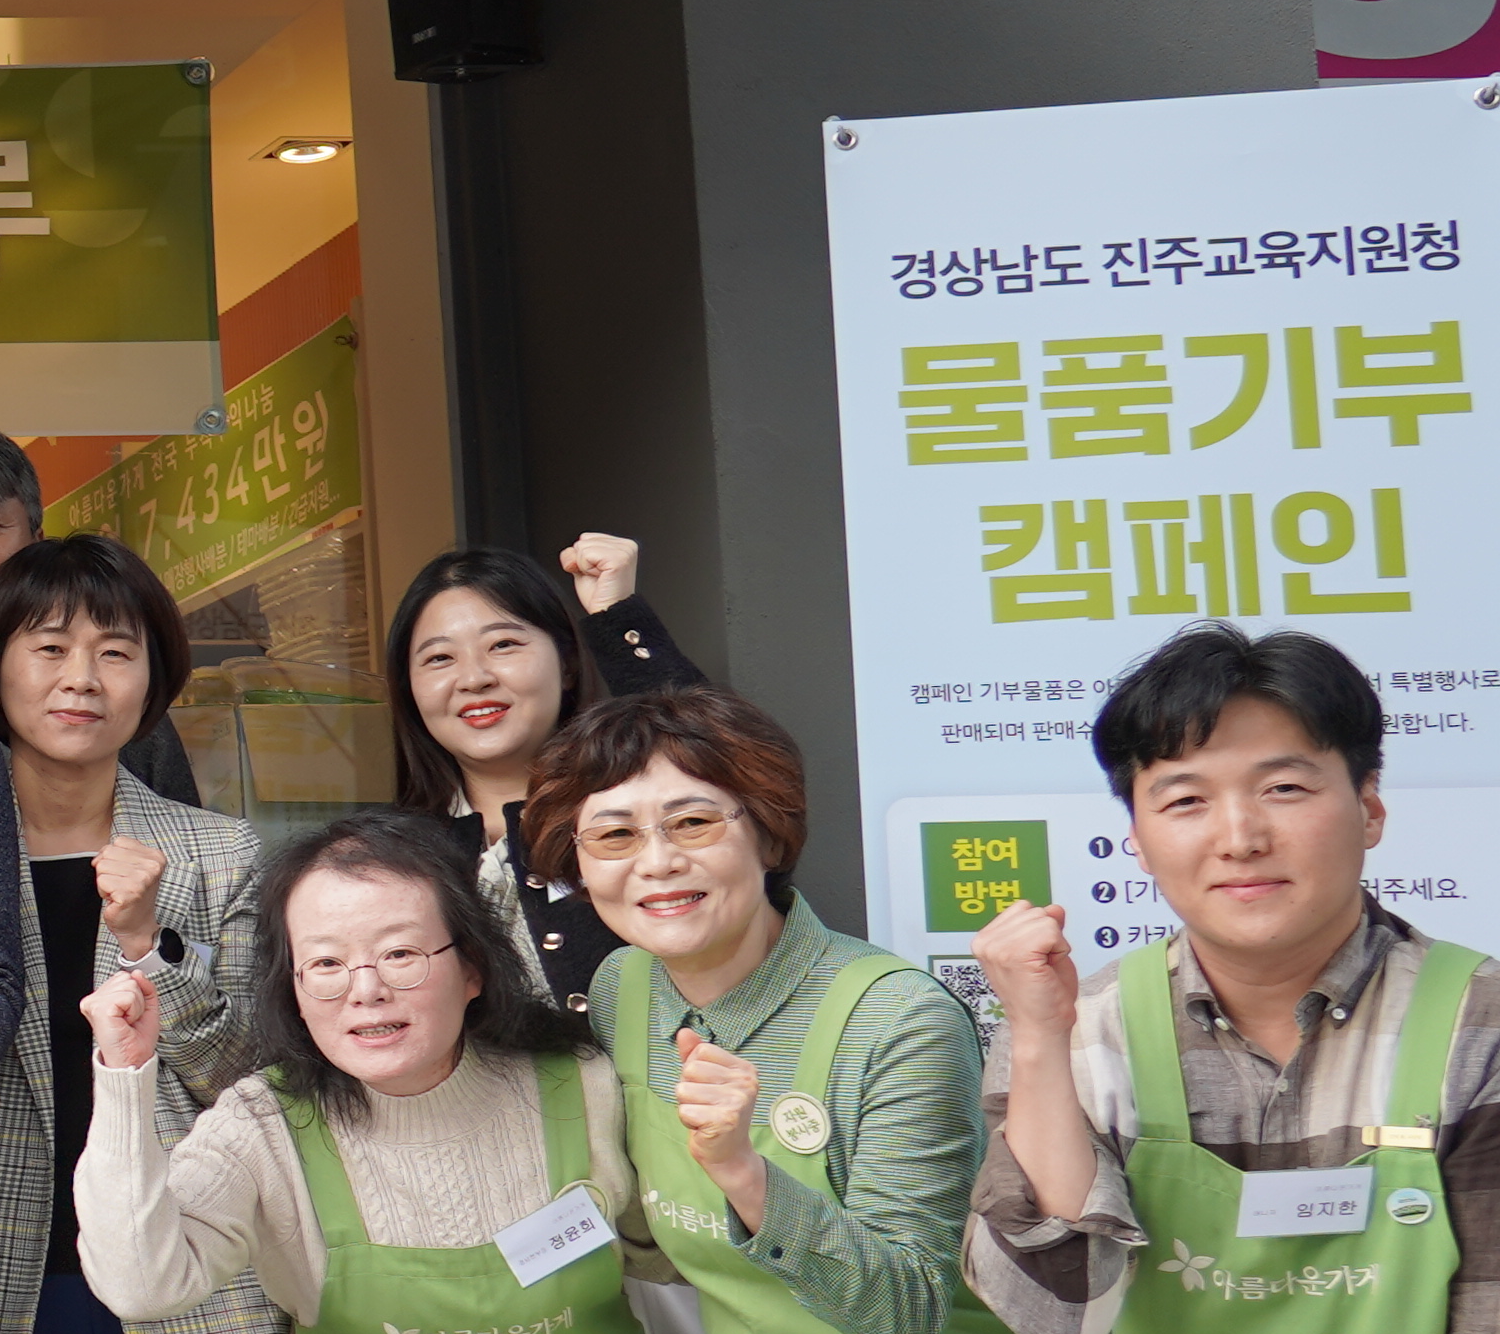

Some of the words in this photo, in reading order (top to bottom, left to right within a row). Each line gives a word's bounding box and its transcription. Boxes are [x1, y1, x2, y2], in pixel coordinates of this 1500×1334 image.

[889, 243, 1091, 301] 경상남도
[1101, 219, 1462, 290] 진주교육지원청
[897, 318, 1474, 467] 물품기부
[68, 452, 145, 528] 아름다운가게
[151, 447, 178, 483] 전국
[978, 486, 1413, 625] 캠페인
[910, 682, 973, 705] 캠페인
[980, 678, 1087, 703] 기부물품은
[1389, 668, 1500, 695] 특별행사로
[941, 719, 1026, 745] 판매되며
[1380, 712, 1474, 736] 원합니다.
[951, 836, 1019, 869] 참여
[954, 879, 1021, 915] 방법
[659, 1200, 730, 1240] 아름다
[1296, 1200, 1357, 1218] 임지한
[548, 1217, 597, 1251] 정윤희
[1212, 1263, 1380, 1301] 아름다운가게
